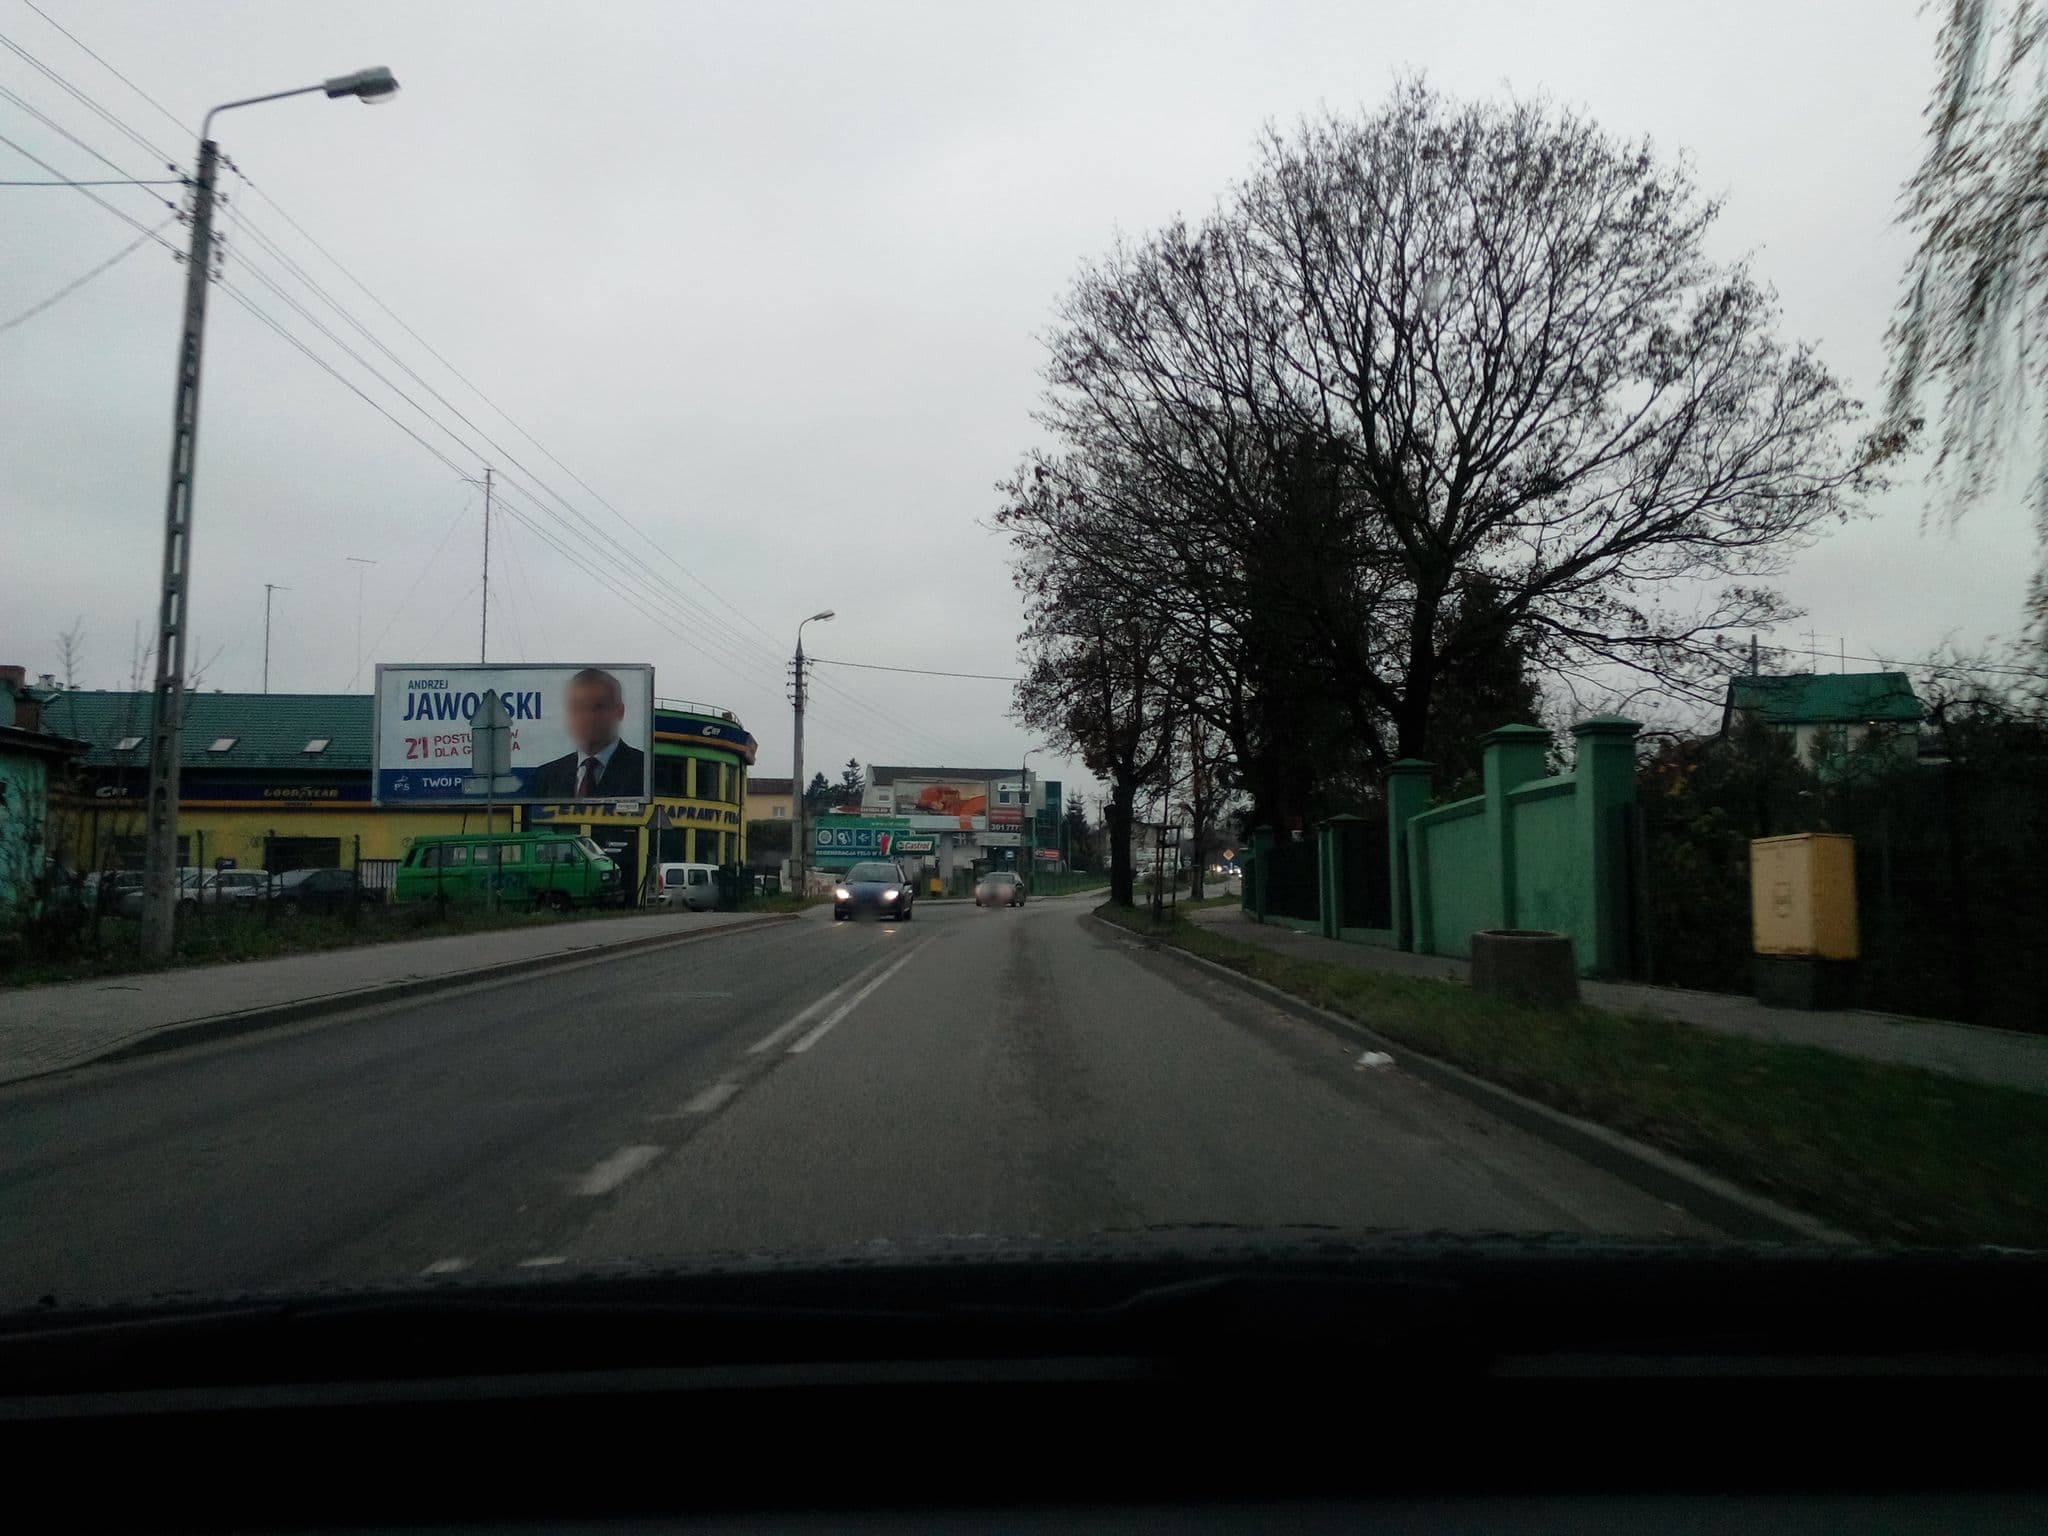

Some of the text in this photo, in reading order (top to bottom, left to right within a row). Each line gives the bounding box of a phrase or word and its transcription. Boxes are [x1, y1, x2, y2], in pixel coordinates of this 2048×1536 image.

[408, 680, 448, 690] ANDRZEJ
[403, 692, 542, 721] JAWOSKI
[405, 737, 429, 760] 21
[434, 747, 459, 758] DLA
[263, 786, 338, 799] GOODYEAR
[905, 841, 930, 849] Castrol
